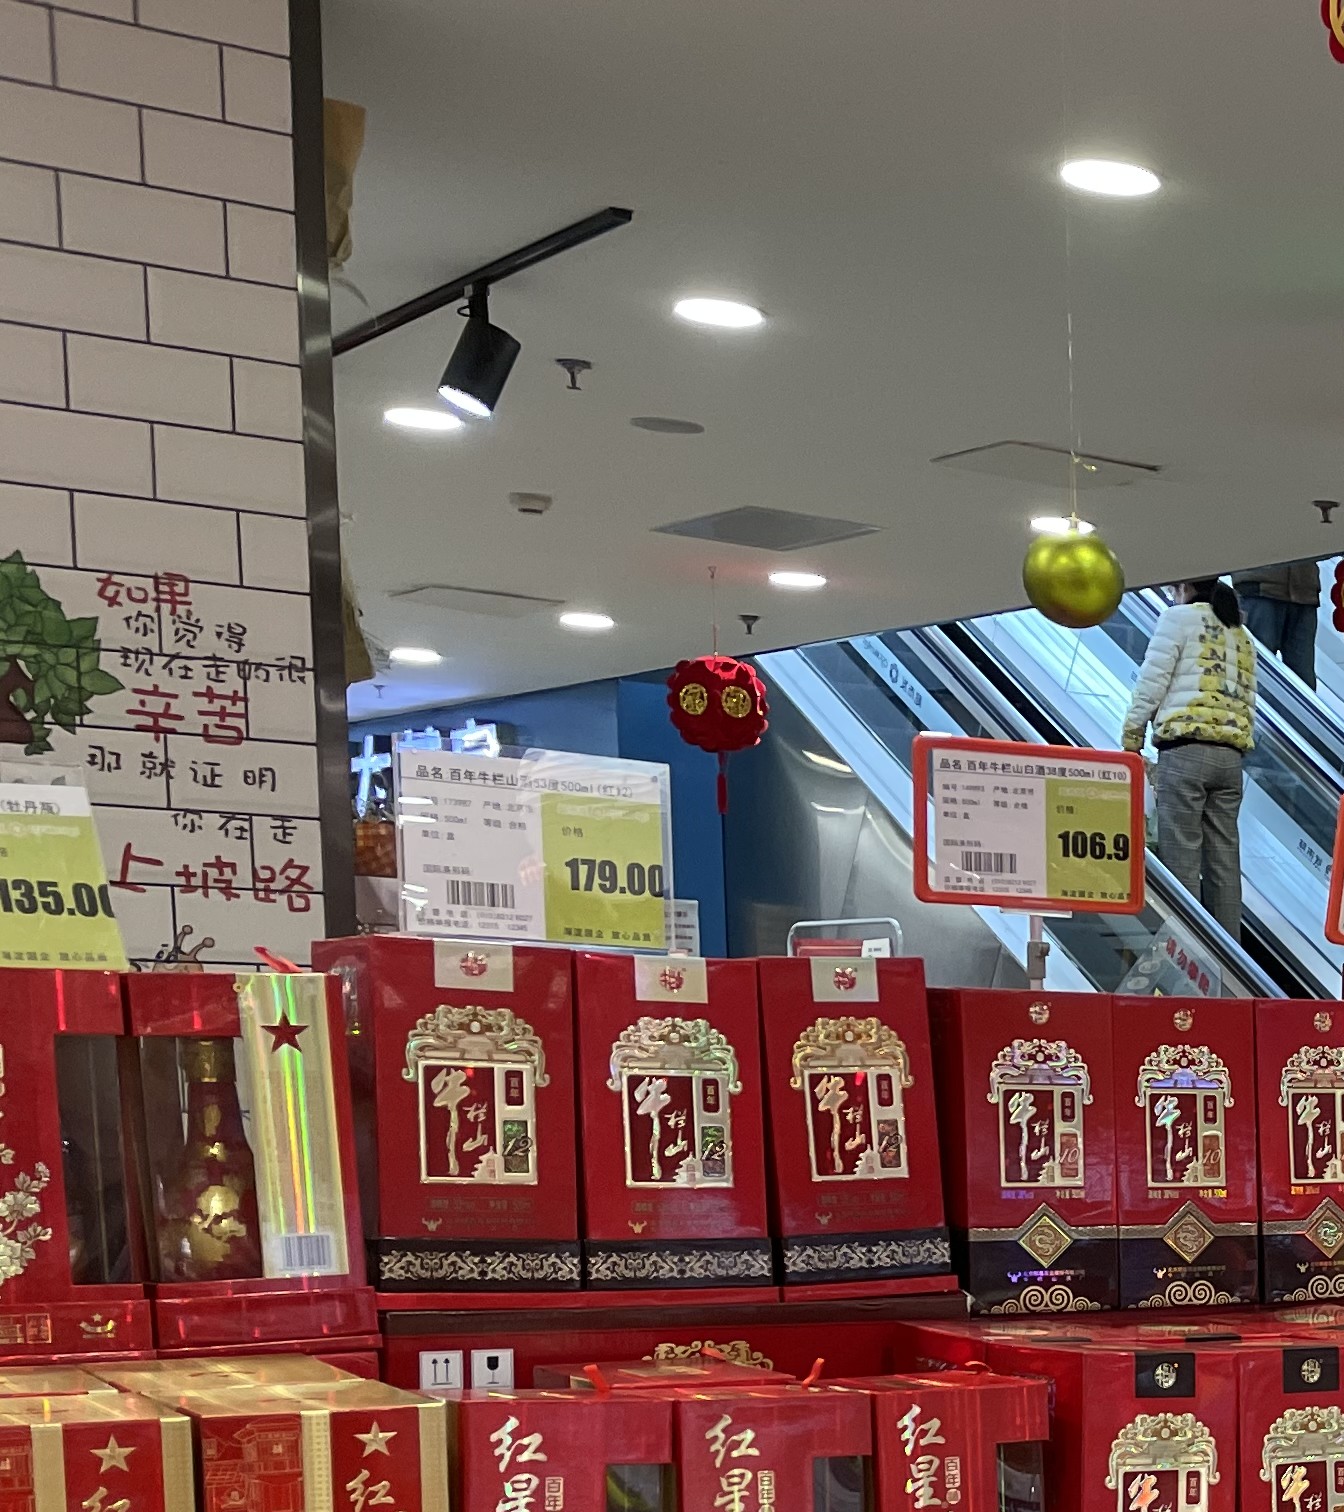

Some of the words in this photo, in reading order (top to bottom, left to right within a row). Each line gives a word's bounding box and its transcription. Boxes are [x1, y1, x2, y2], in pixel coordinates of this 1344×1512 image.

[96, 572, 193, 612] 如果
[122, 612, 247, 654] 你觉得
[120, 647, 308, 686] 现在走的很
[125, 684, 249, 745] 辛苦
[87, 745, 277, 793] 那就证明
[171, 809, 298, 845] 你在走
[1057, 830, 1130, 862] 106.9
[109, 841, 314, 914] 上坡路
[564, 857, 665, 898] 179.00
[896, 1403, 946, 1510] 红星
